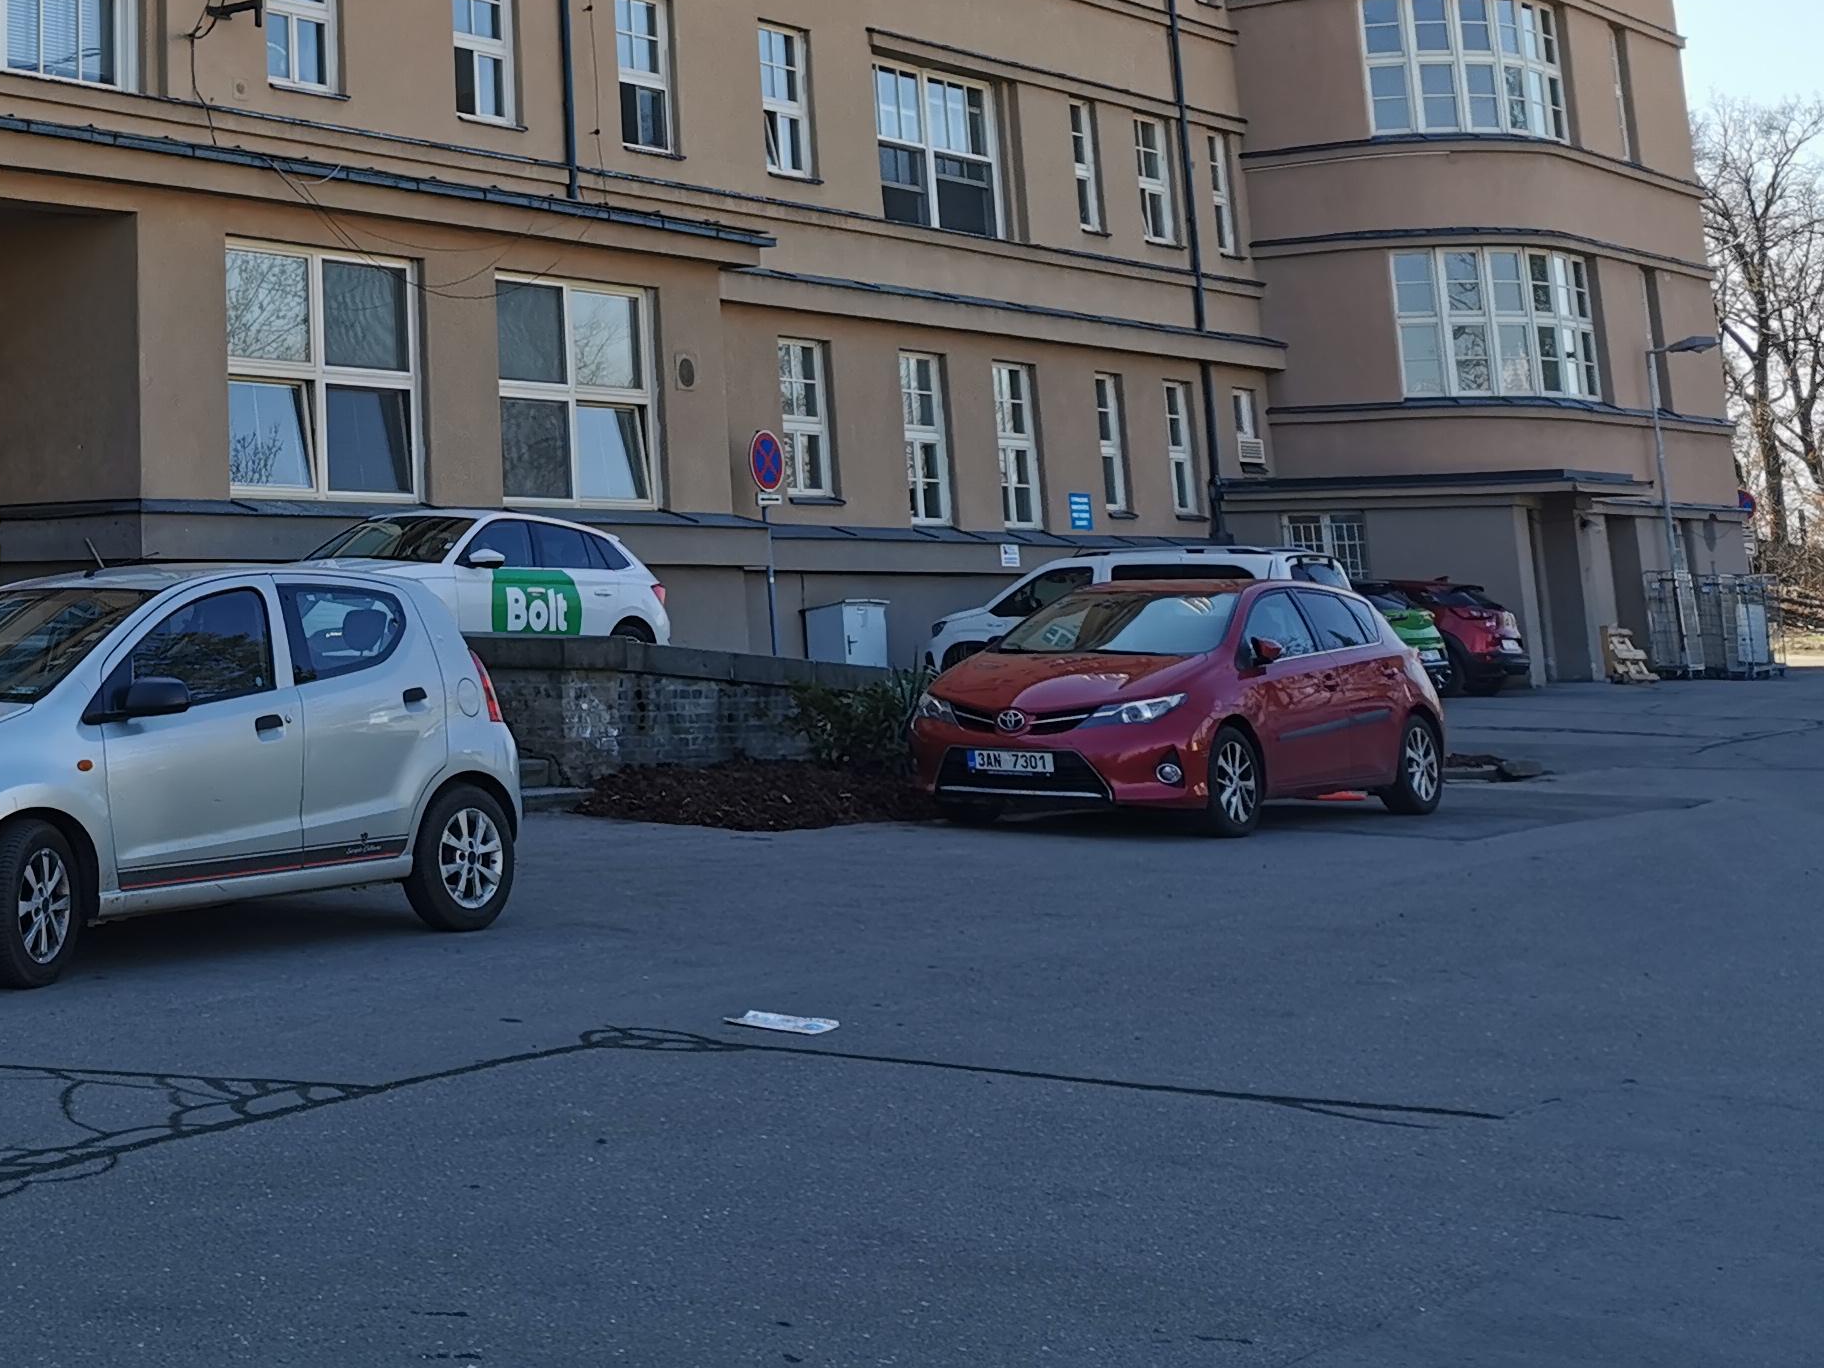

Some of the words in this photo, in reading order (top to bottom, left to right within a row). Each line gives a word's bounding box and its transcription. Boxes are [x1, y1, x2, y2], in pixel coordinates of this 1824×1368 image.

[505, 586, 568, 632] Bolt
[977, 752, 1002, 768] 3AN
[1011, 753, 1047, 770] 7301
